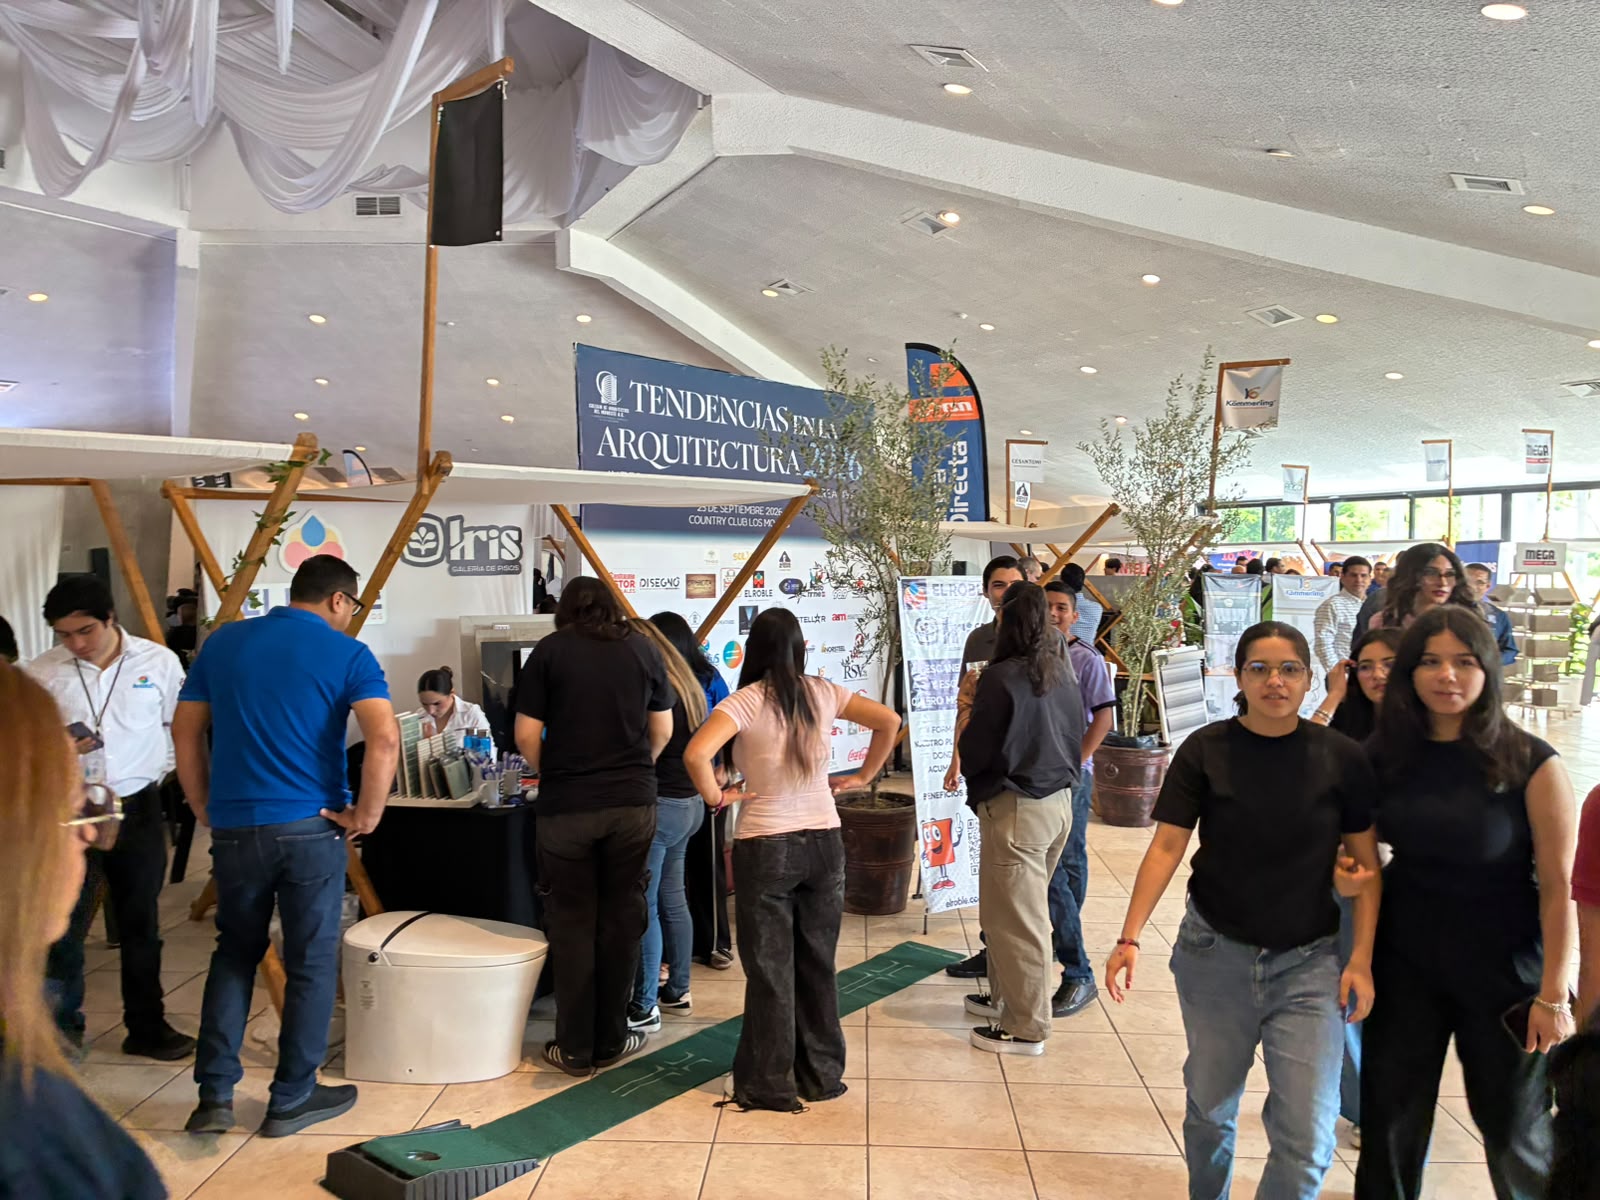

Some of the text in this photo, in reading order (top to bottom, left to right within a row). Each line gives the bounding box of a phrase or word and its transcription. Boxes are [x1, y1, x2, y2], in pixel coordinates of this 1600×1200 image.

[629, 380, 788, 433] TENDENCIAS
[597, 426, 801, 475] ARQUITECTURA
[689, 515, 726, 525] COUNTRY
[728, 517, 747, 526] CLUB
[749, 518, 762, 527] LOS
[720, 505, 764, 515] SEPTIEMBRE
[450, 519, 521, 561] Iris
[1526, 550, 1554, 559] MEGA
